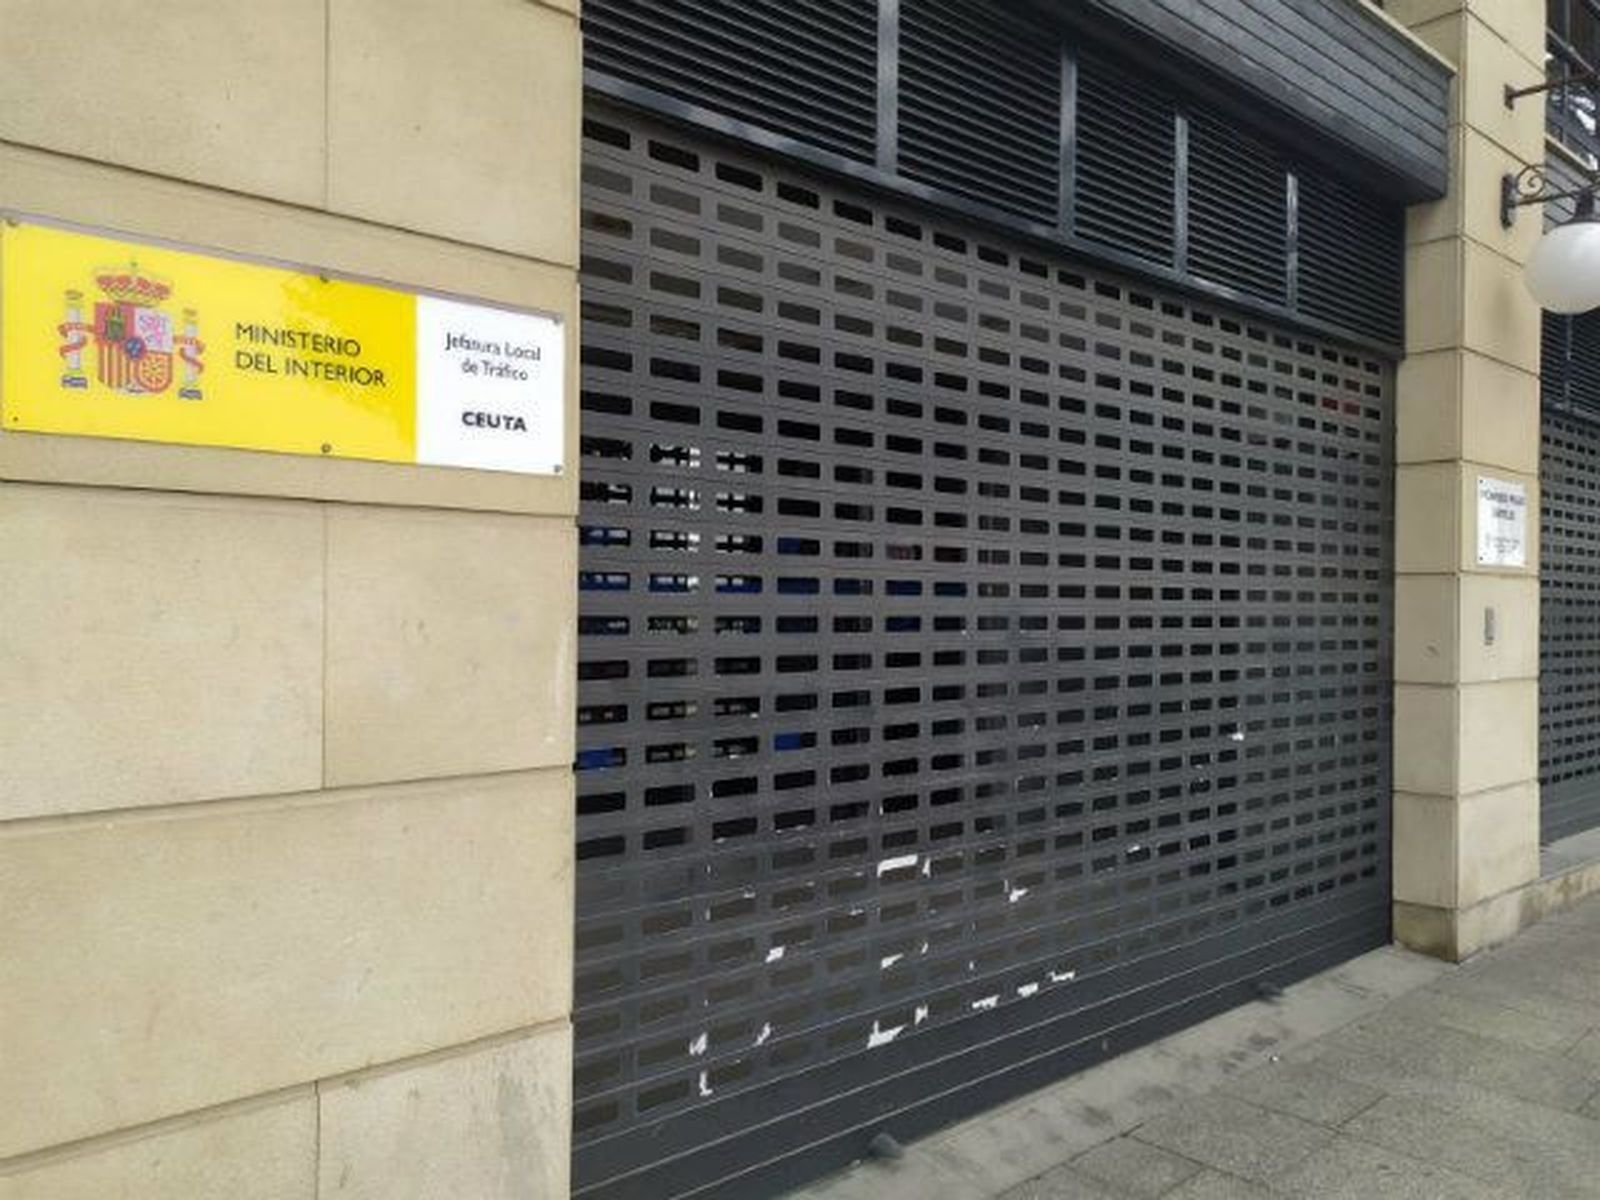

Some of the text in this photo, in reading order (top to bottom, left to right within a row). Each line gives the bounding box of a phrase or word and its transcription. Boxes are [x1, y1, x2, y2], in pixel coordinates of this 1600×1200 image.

[236, 322, 361, 357] MINISTERIO
[505, 342, 541, 361] Local
[236, 351, 386, 388] DEL INTERIOR
[461, 358, 528, 381] de Tráfico
[461, 411, 528, 433] CEUTA
